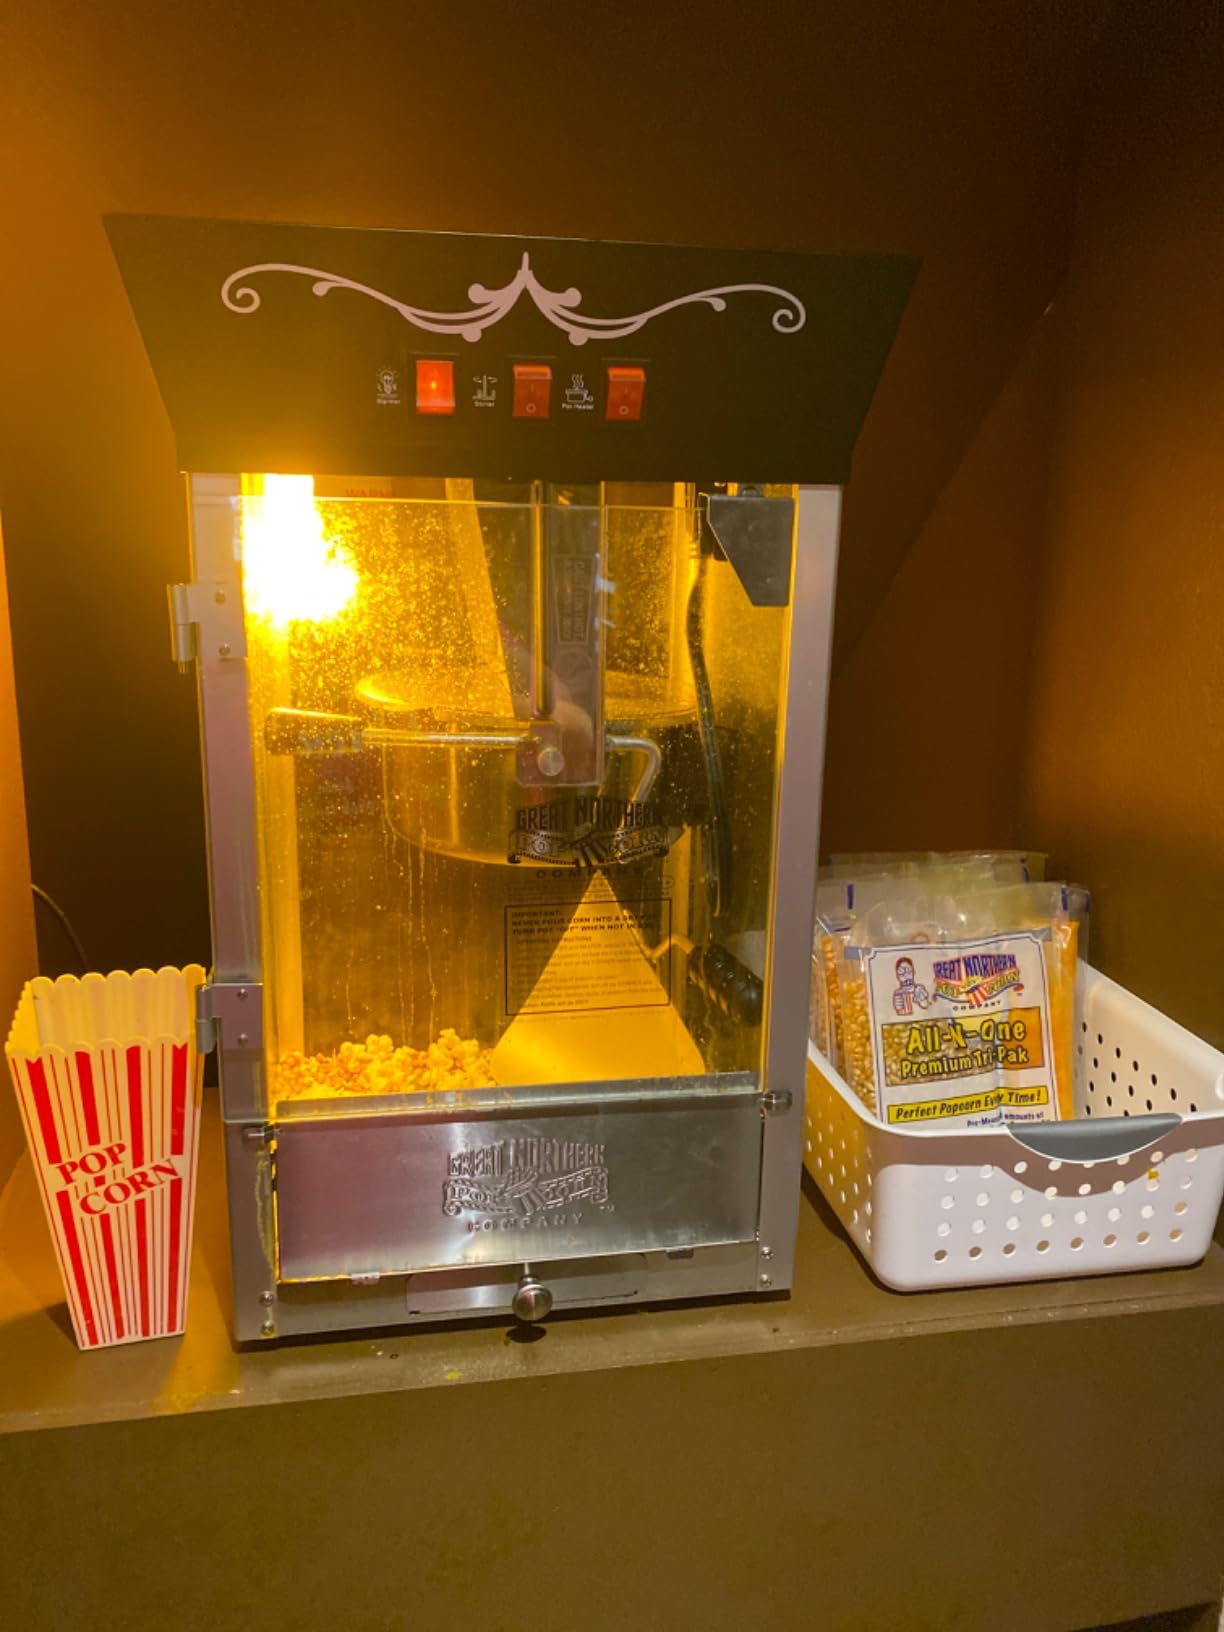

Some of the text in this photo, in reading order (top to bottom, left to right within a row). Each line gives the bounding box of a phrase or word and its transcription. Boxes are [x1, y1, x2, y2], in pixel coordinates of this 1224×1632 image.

[516, 803, 572, 830] GREAT
[908, 1020, 1026, 1053] All-N-One
[901, 1056, 972, 1079] Premium
[896, 1103, 938, 1120] Perfect
[940, 1099, 982, 1116] Popcorn
[1007, 1089, 1041, 1104] Time!
[57, 1142, 126, 1185] POP
[447, 1139, 505, 1177] GREAT
[79, 1158, 181, 1215] CORN
